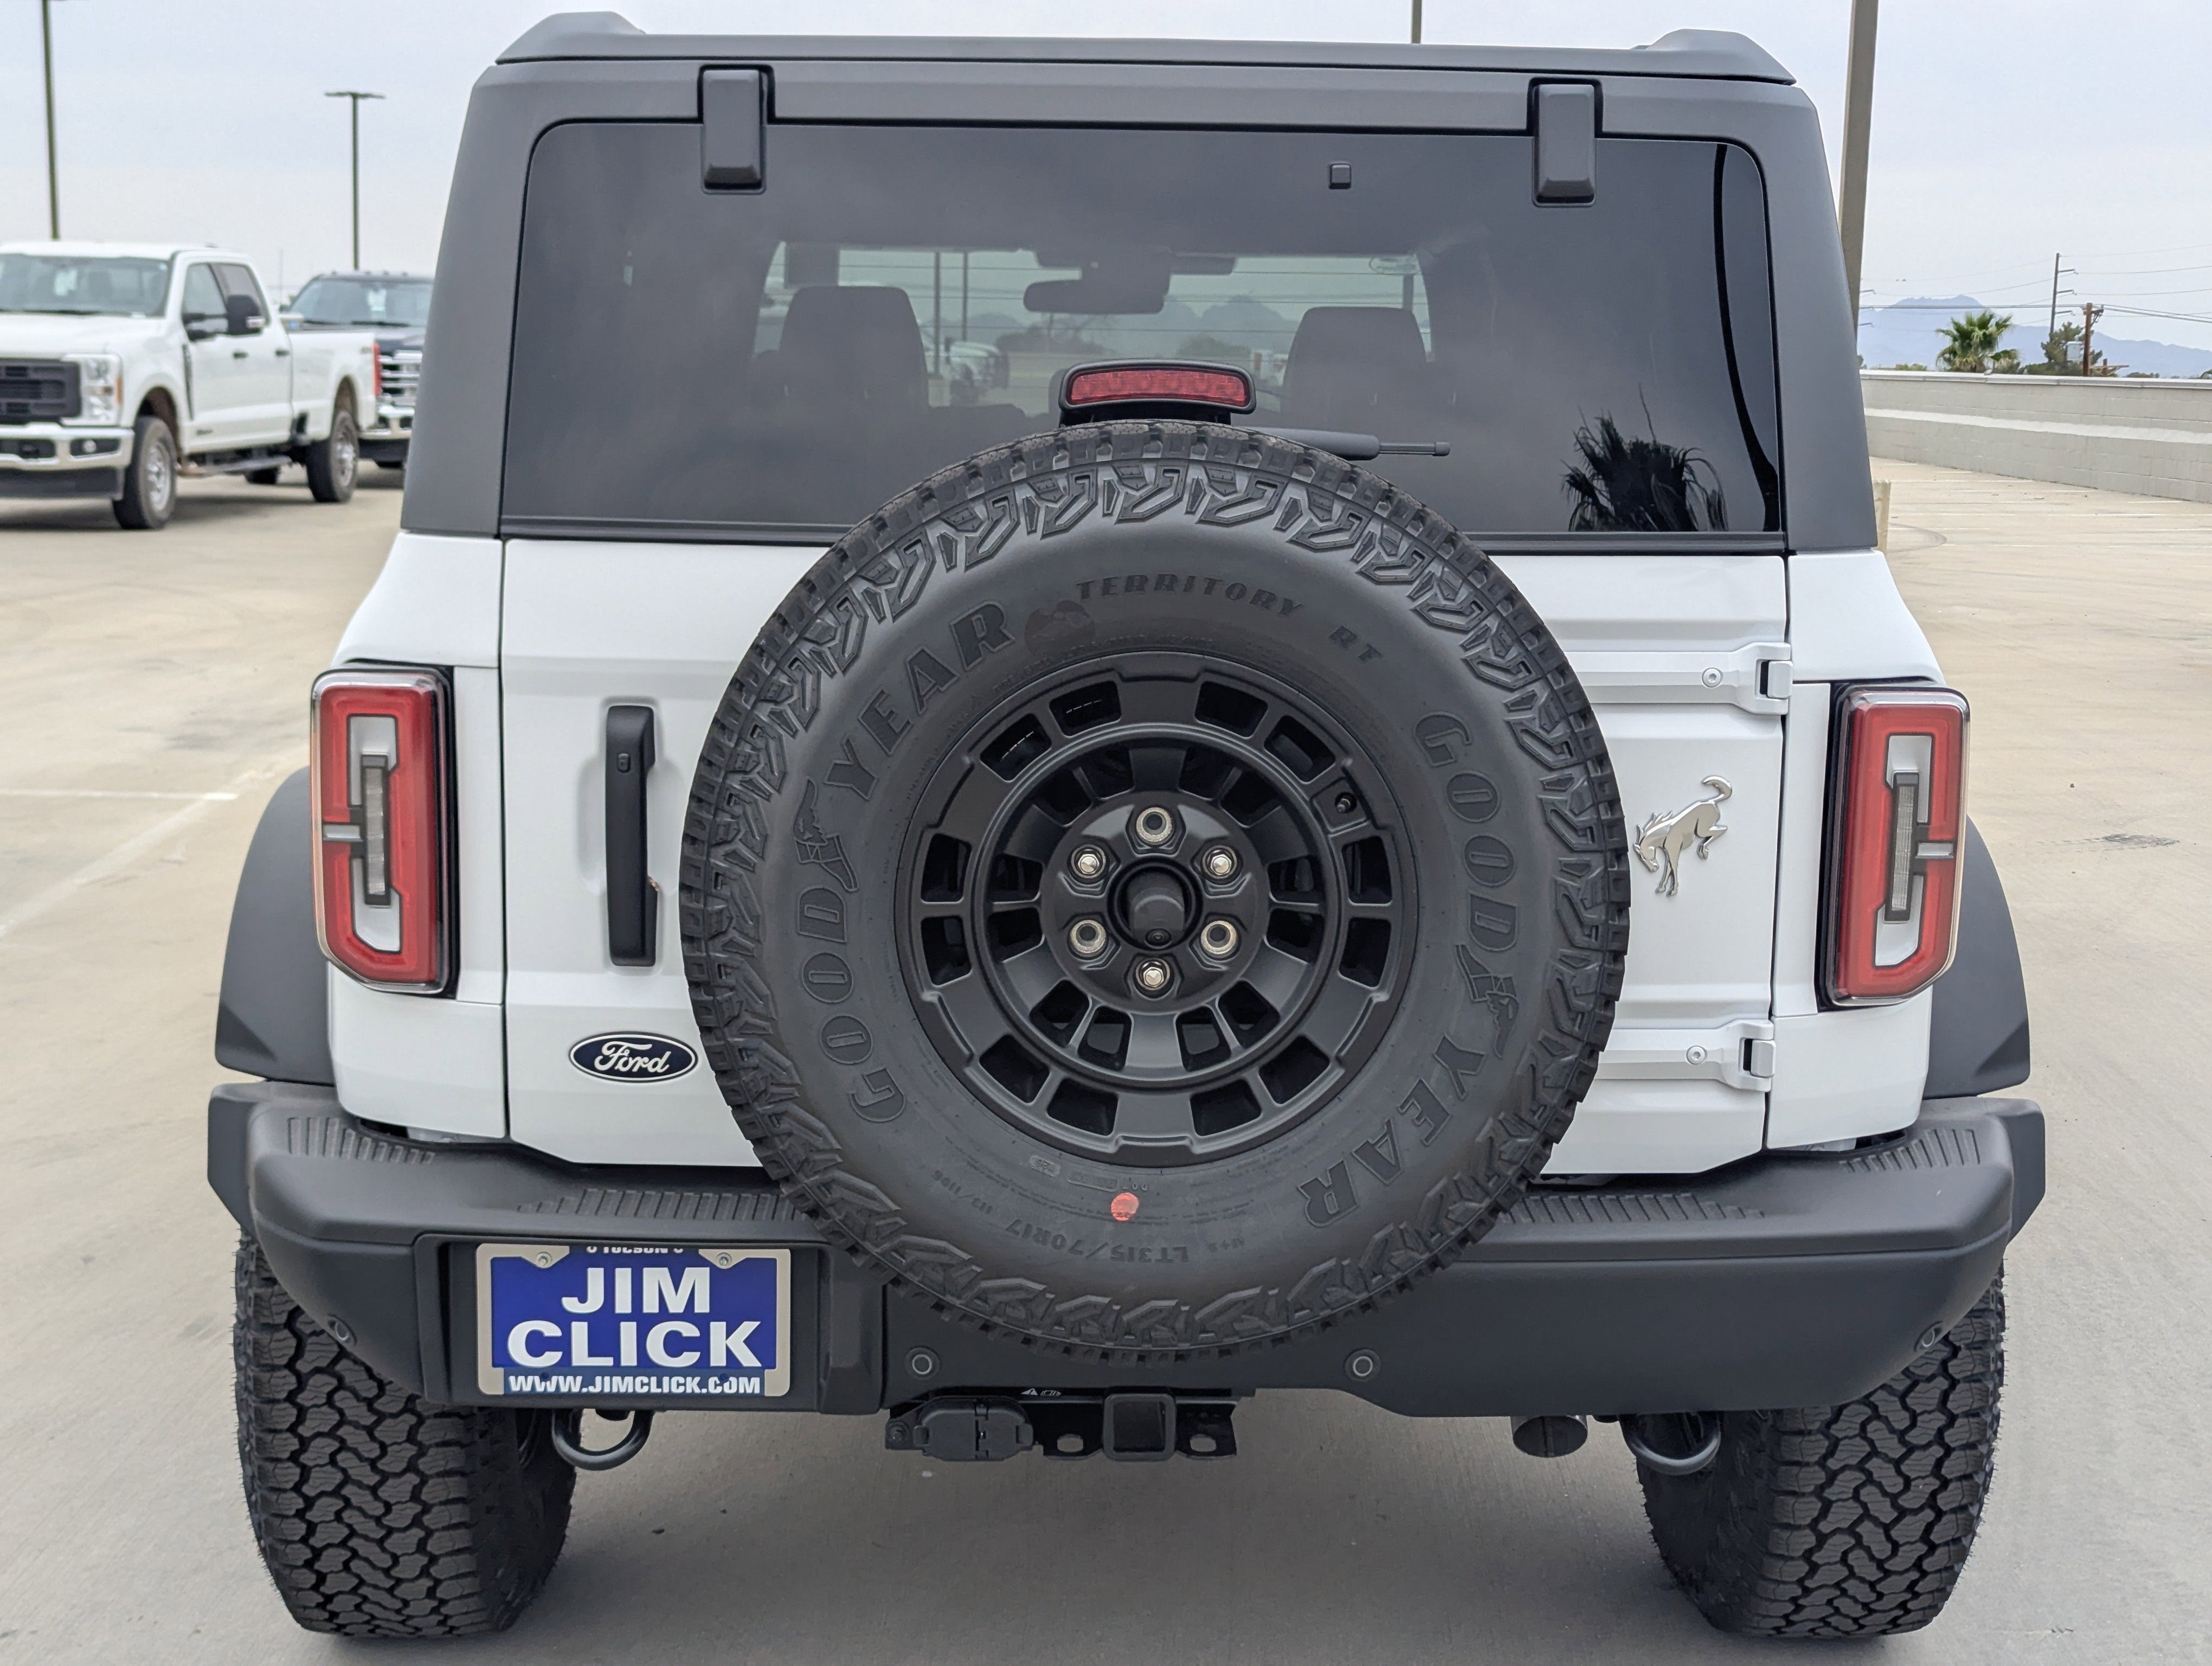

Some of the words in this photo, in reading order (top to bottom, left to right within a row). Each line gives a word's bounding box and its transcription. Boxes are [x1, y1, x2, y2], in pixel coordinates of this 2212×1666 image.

[1076, 573, 1305, 618] TERRITORY
[1328, 625, 1382, 663] RT
[594, 1040, 672, 1073] Ford
[1005, 1219, 1190, 1263] LT315/70R17
[561, 1267, 710, 1314] JIM
[507, 1321, 762, 1368] CLICK
[508, 1375, 761, 1394] WWW.JIMCLICK.COM
